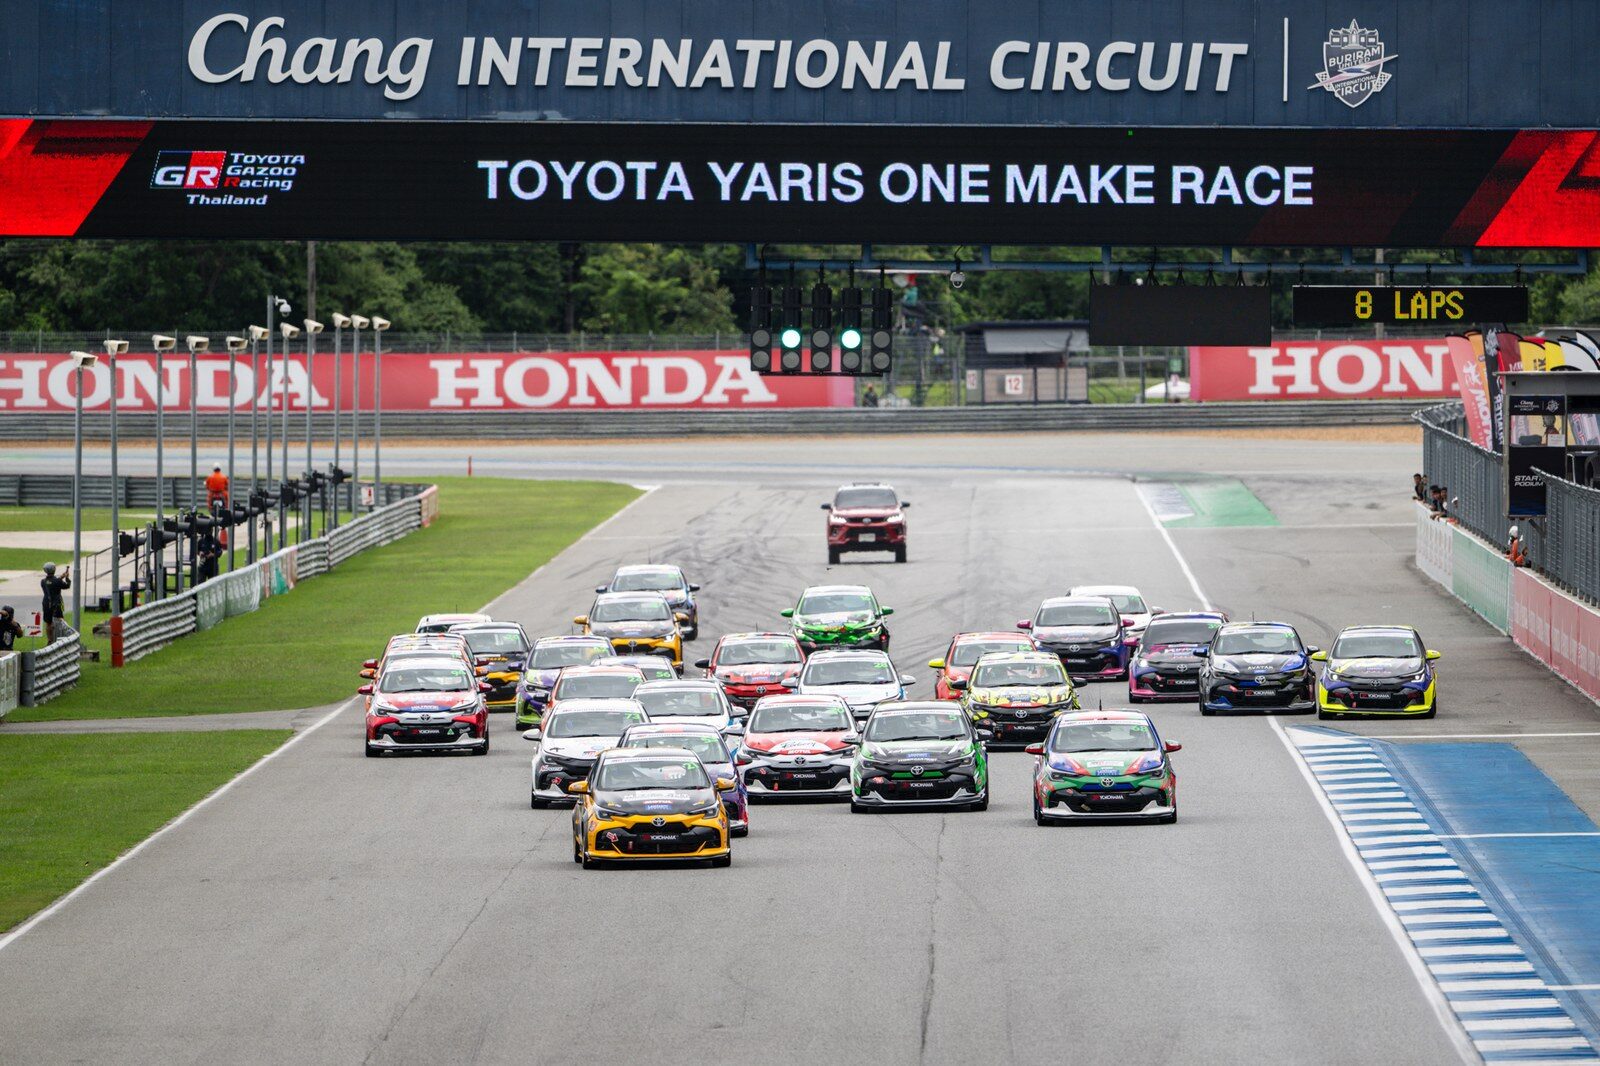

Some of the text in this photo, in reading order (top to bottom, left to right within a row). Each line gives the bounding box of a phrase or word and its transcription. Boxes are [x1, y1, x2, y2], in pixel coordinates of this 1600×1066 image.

[187, 13, 1249, 101] Chang INTERNATIONAL CIRCUIT
[1328, 47, 1381, 67] BURIRAM
[1338, 57, 1371, 69] UNITED
[1334, 74, 1377, 88] INTERNATIONAL
[1334, 80, 1377, 97] CIRCUIT
[231, 152, 305, 164] TOYOTA
[154, 165, 218, 187] GR
[226, 164, 296, 176] GAZOO
[224, 177, 293, 191] Racing
[478, 159, 1314, 206] TOYOTA YARIS ONE MAKE RACE
[186, 194, 268, 206] Thailand
[1355, 290, 1464, 320] 8 LAPS
[1248, 344, 1462, 395] HON
[429, 356, 778, 407] HONDA
[1008, 377, 1021, 391] 12
